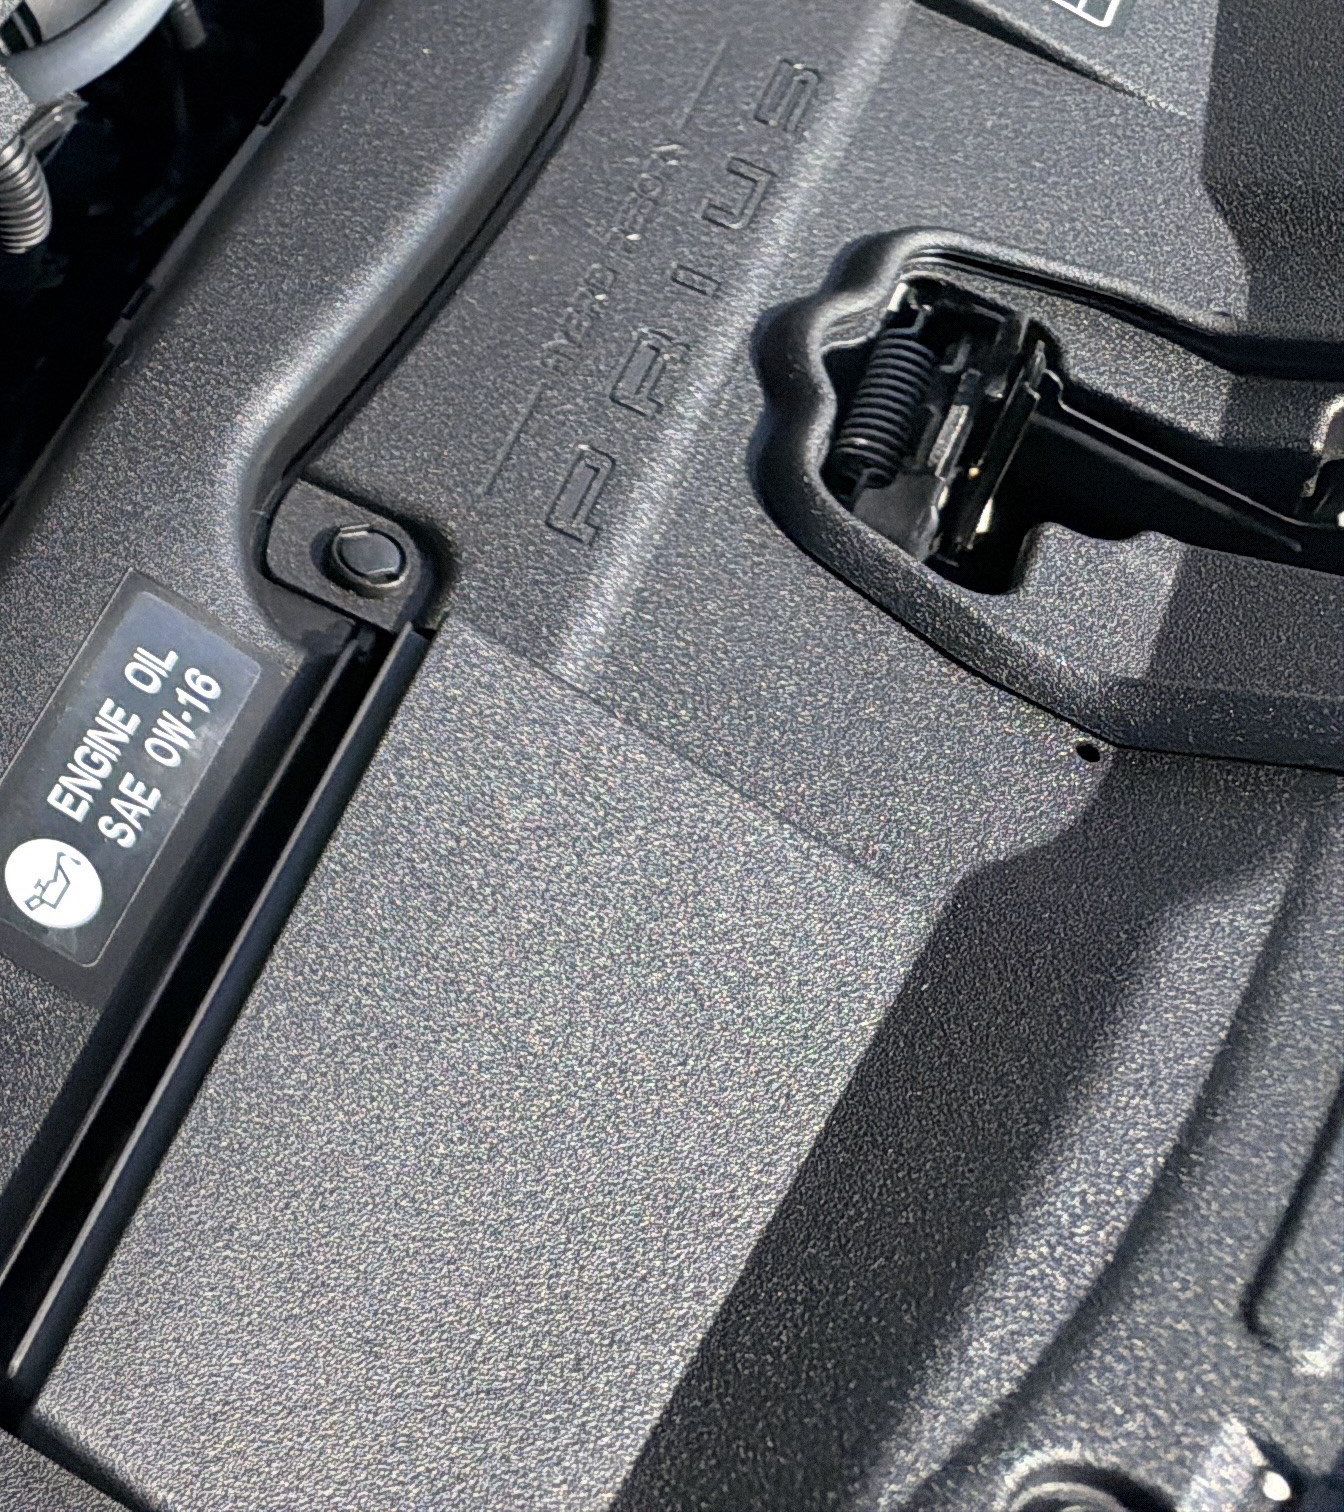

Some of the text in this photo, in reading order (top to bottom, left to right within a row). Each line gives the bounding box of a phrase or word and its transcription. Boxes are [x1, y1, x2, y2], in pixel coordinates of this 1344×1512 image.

[546, 58, 822, 548] PRIUS
[47, 646, 178, 822] ENGINE OIL
[98, 772, 161, 848] SAE
